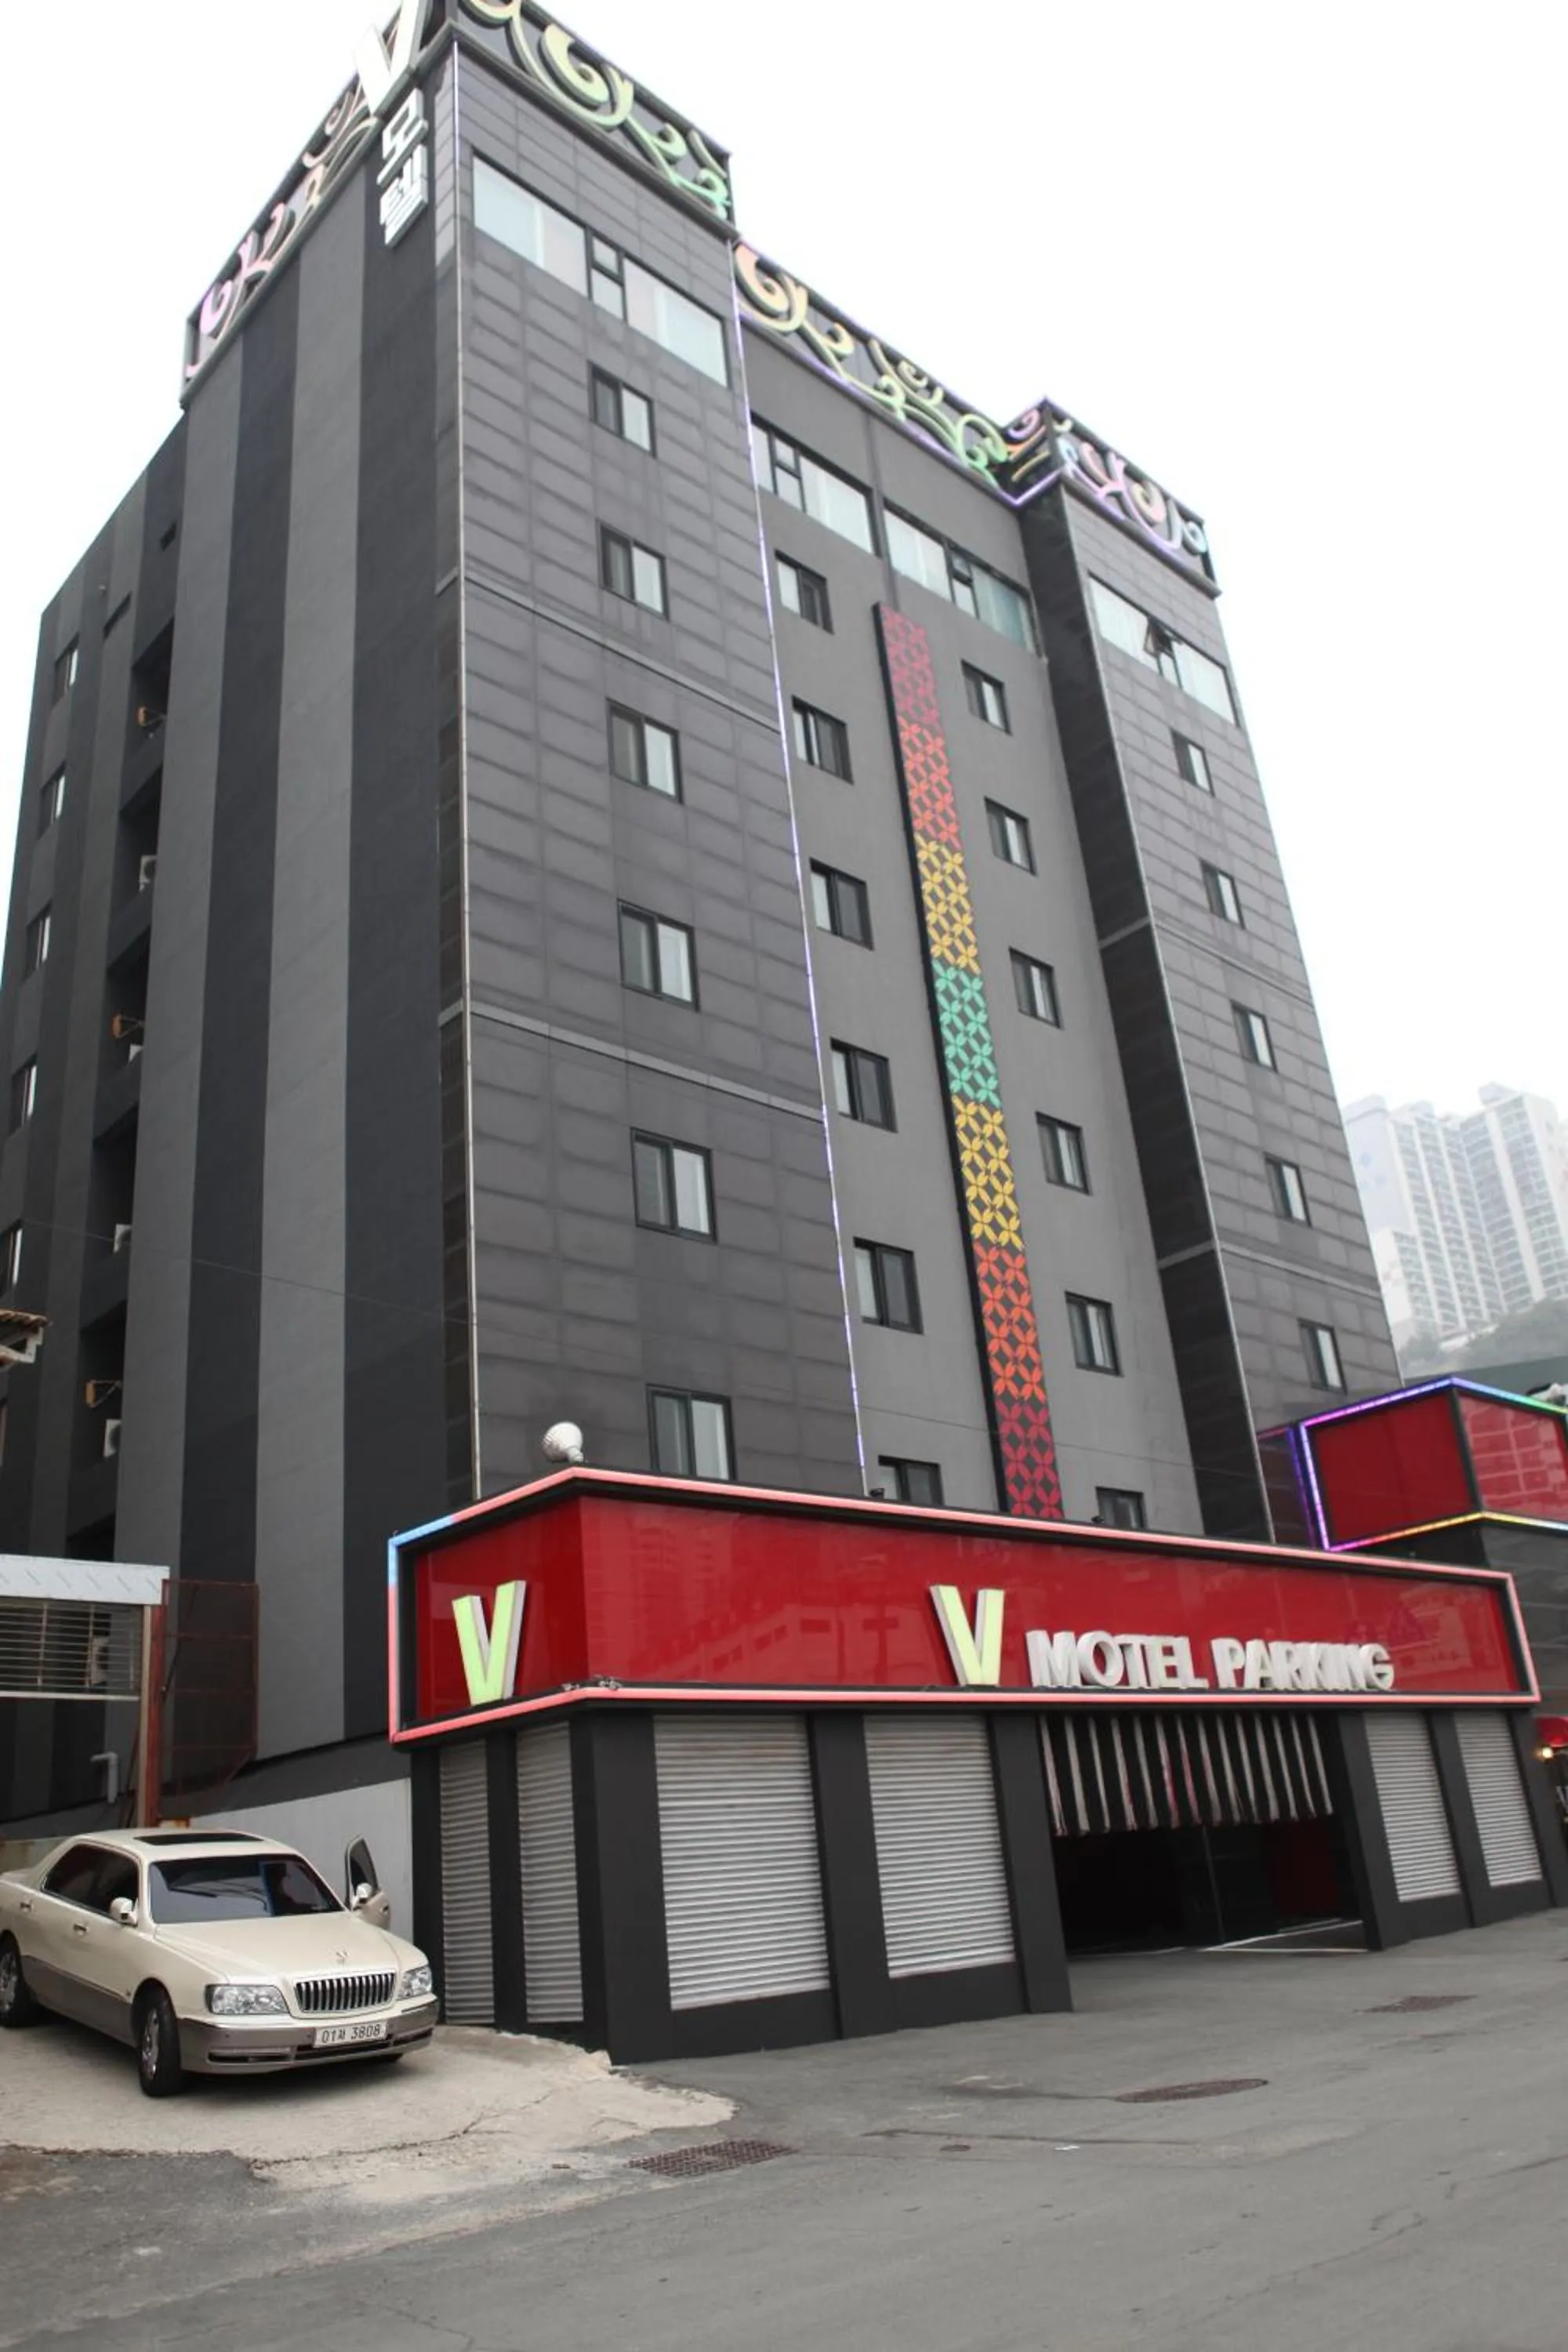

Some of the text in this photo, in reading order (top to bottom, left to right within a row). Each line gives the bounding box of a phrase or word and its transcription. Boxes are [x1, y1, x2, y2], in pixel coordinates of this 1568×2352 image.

[377, 87, 429, 245] 모텔
[452, 1581, 527, 1706] V
[930, 1585, 1395, 1690] V MOTEL PARKING
